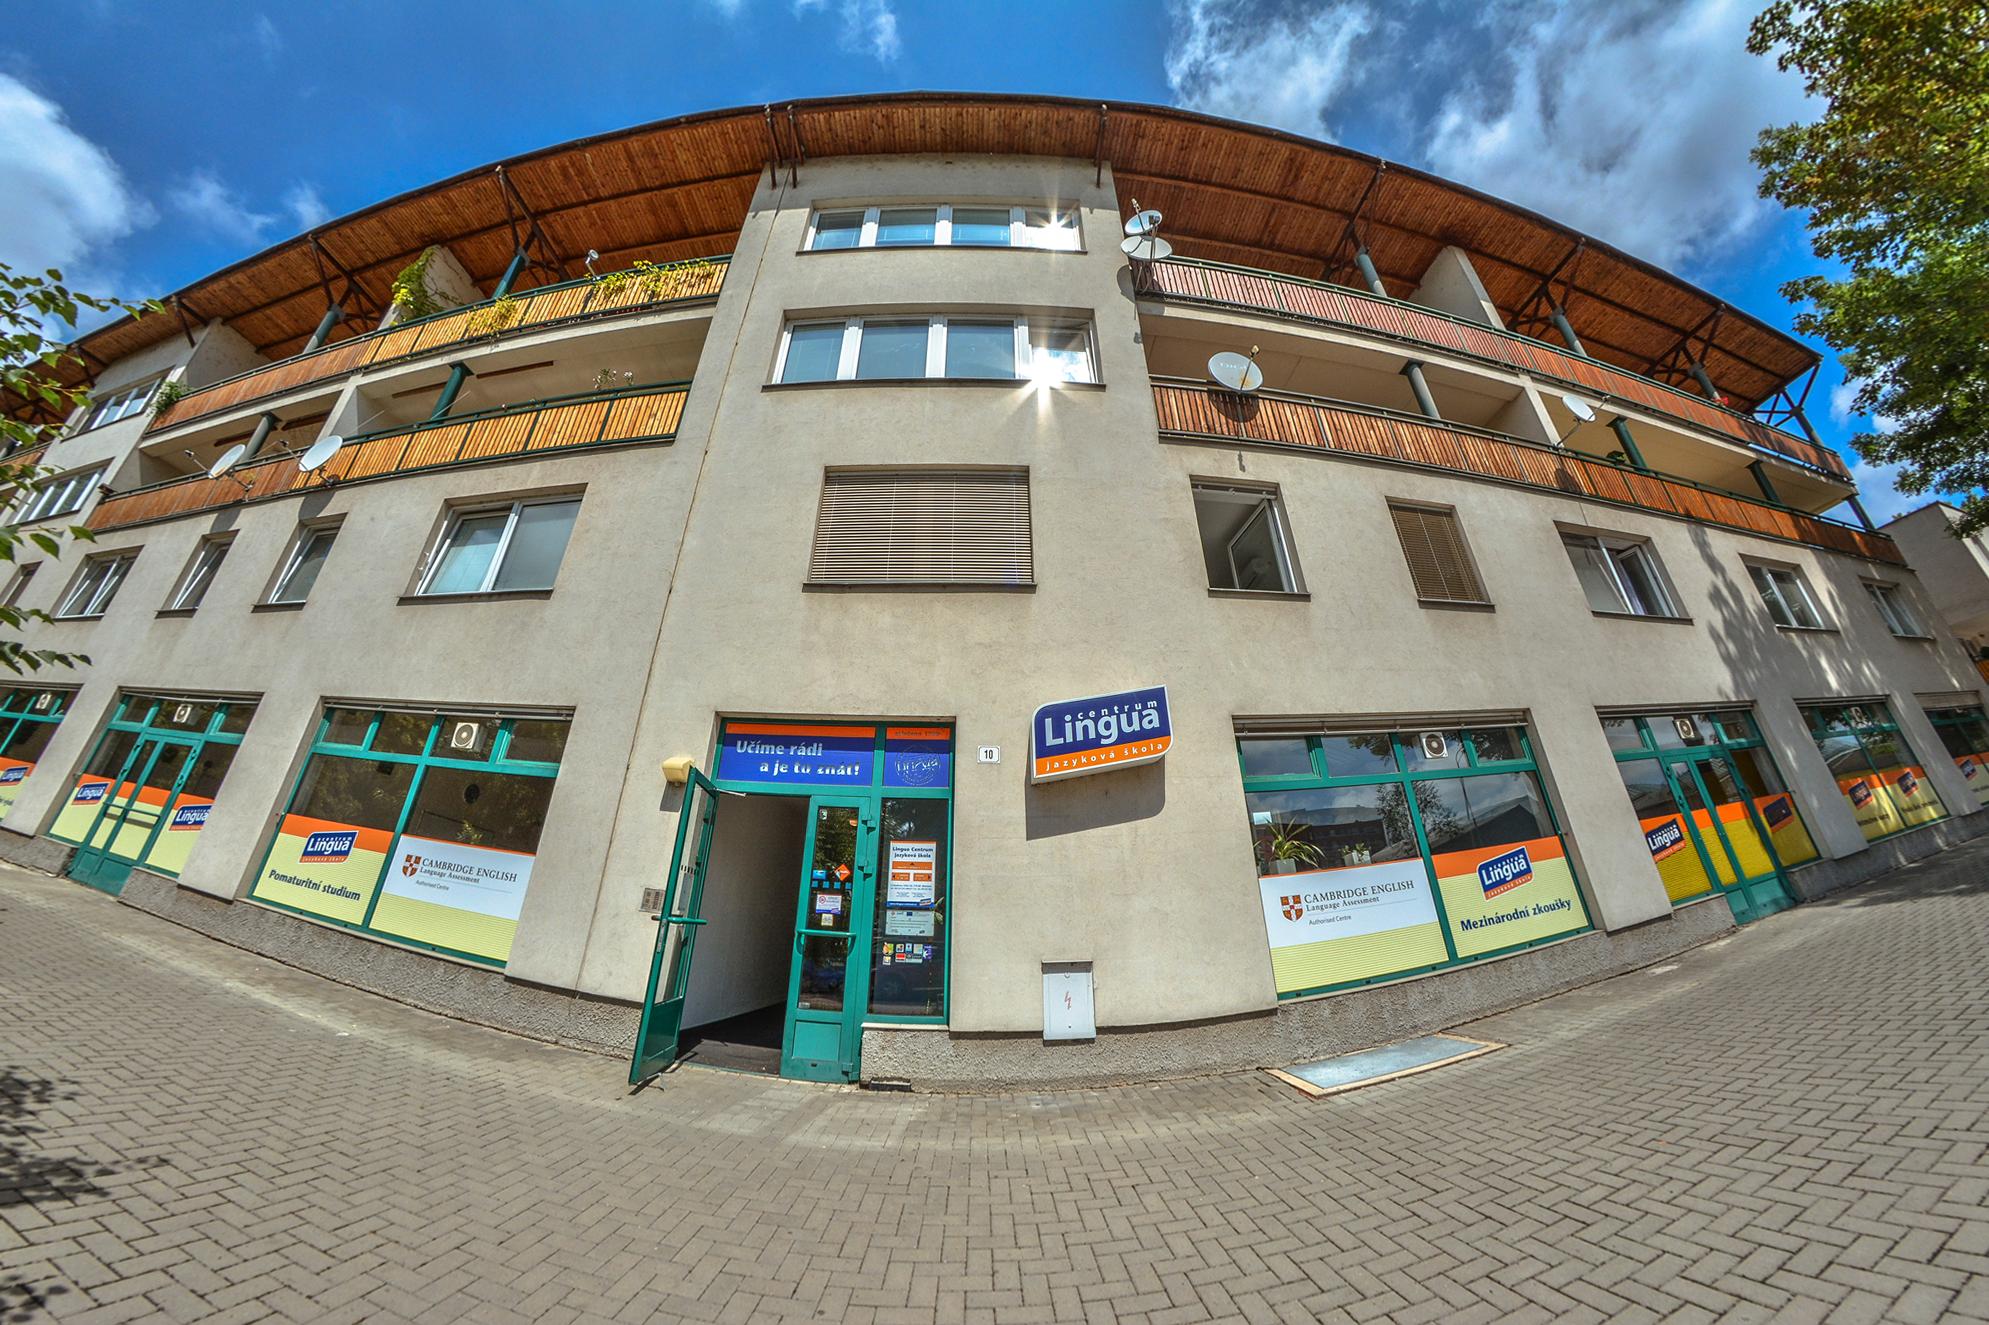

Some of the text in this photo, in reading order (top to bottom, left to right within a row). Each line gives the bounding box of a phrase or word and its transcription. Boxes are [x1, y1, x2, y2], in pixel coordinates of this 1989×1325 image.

[1077, 700, 1158, 719] centrum
[1044, 708, 1160, 746] Lingua
[736, 740, 823, 756] Učíme rádi
[984, 750, 994, 760] 10
[1046, 743, 1163, 771] jazyková škola
[760, 762, 769, 773] a
[773, 760, 789, 776] je
[175, 810, 209, 824] Lingua
[307, 838, 351, 855] Lingua
[1648, 828, 1681, 850] Lingua
[420, 866, 481, 883] Language Assessment
[422, 858, 518, 882] CAMBRIDGE ENGLISH
[1482, 858, 1528, 885] Lingua
[268, 869, 361, 901] Pomaturitní studium
[1304, 880, 1415, 904] CAMBRIDGE ENGLISH
[1306, 896, 1380, 912] Language Assessment
[1460, 898, 1572, 932] Mezinárodní zkoušky
